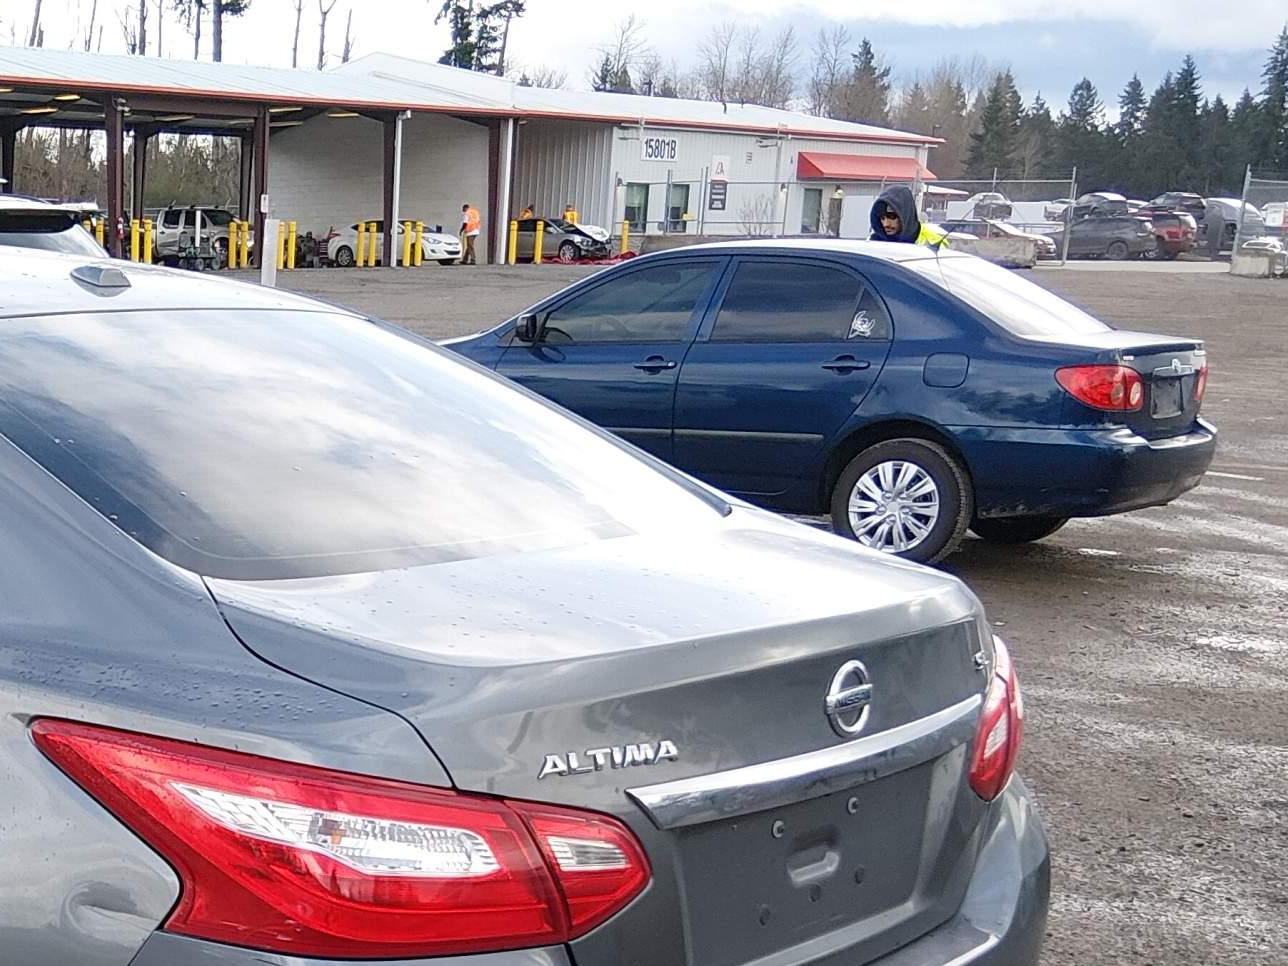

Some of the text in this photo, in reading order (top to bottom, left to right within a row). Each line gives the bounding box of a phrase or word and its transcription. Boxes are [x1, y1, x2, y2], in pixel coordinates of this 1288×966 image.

[644, 138, 677, 160] 15801B
[834, 689, 872, 710] NISSAN
[537, 739, 679, 780] ALTIMA
